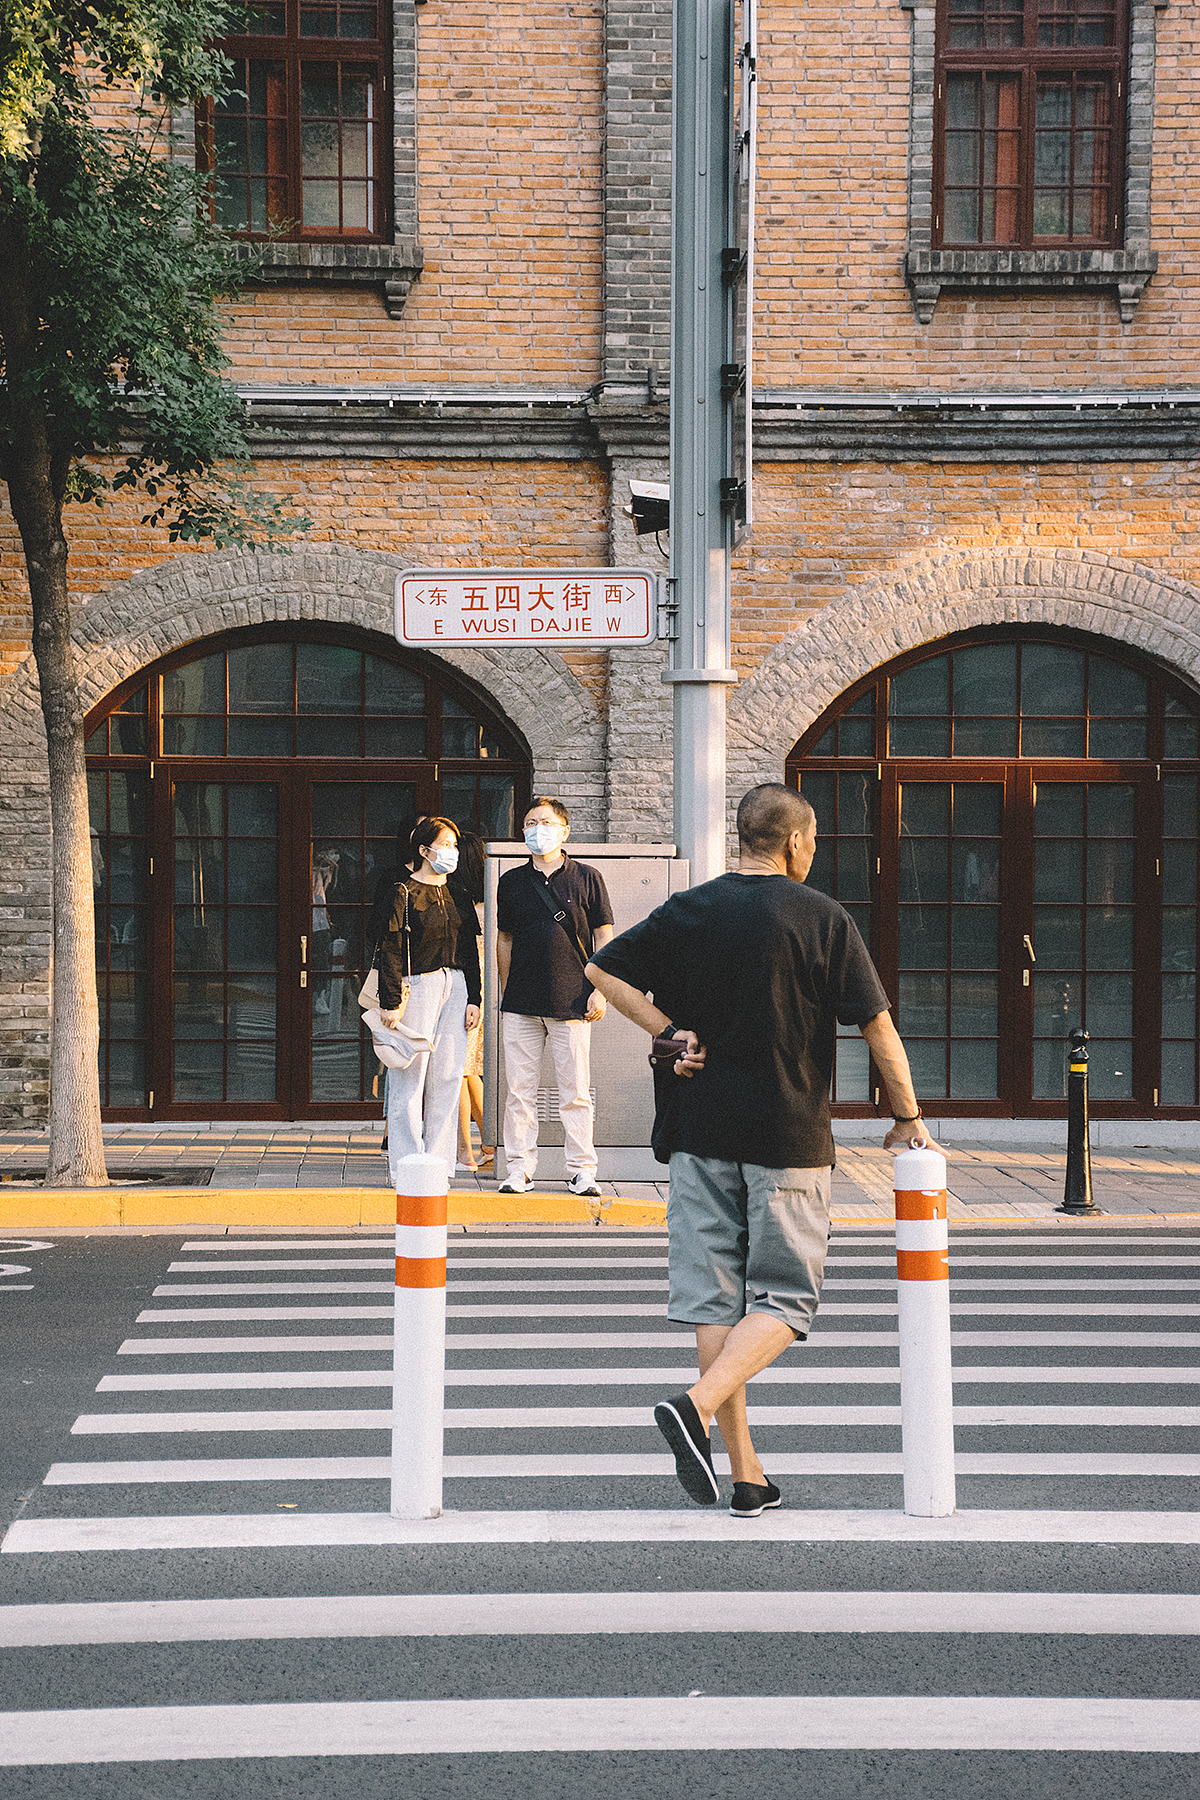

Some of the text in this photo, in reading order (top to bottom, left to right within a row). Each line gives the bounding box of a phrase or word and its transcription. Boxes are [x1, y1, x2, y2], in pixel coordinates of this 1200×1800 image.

[428, 583, 623, 612] 东 五四大街 西
[434, 617, 621, 634] E WUSI DAJIE W
